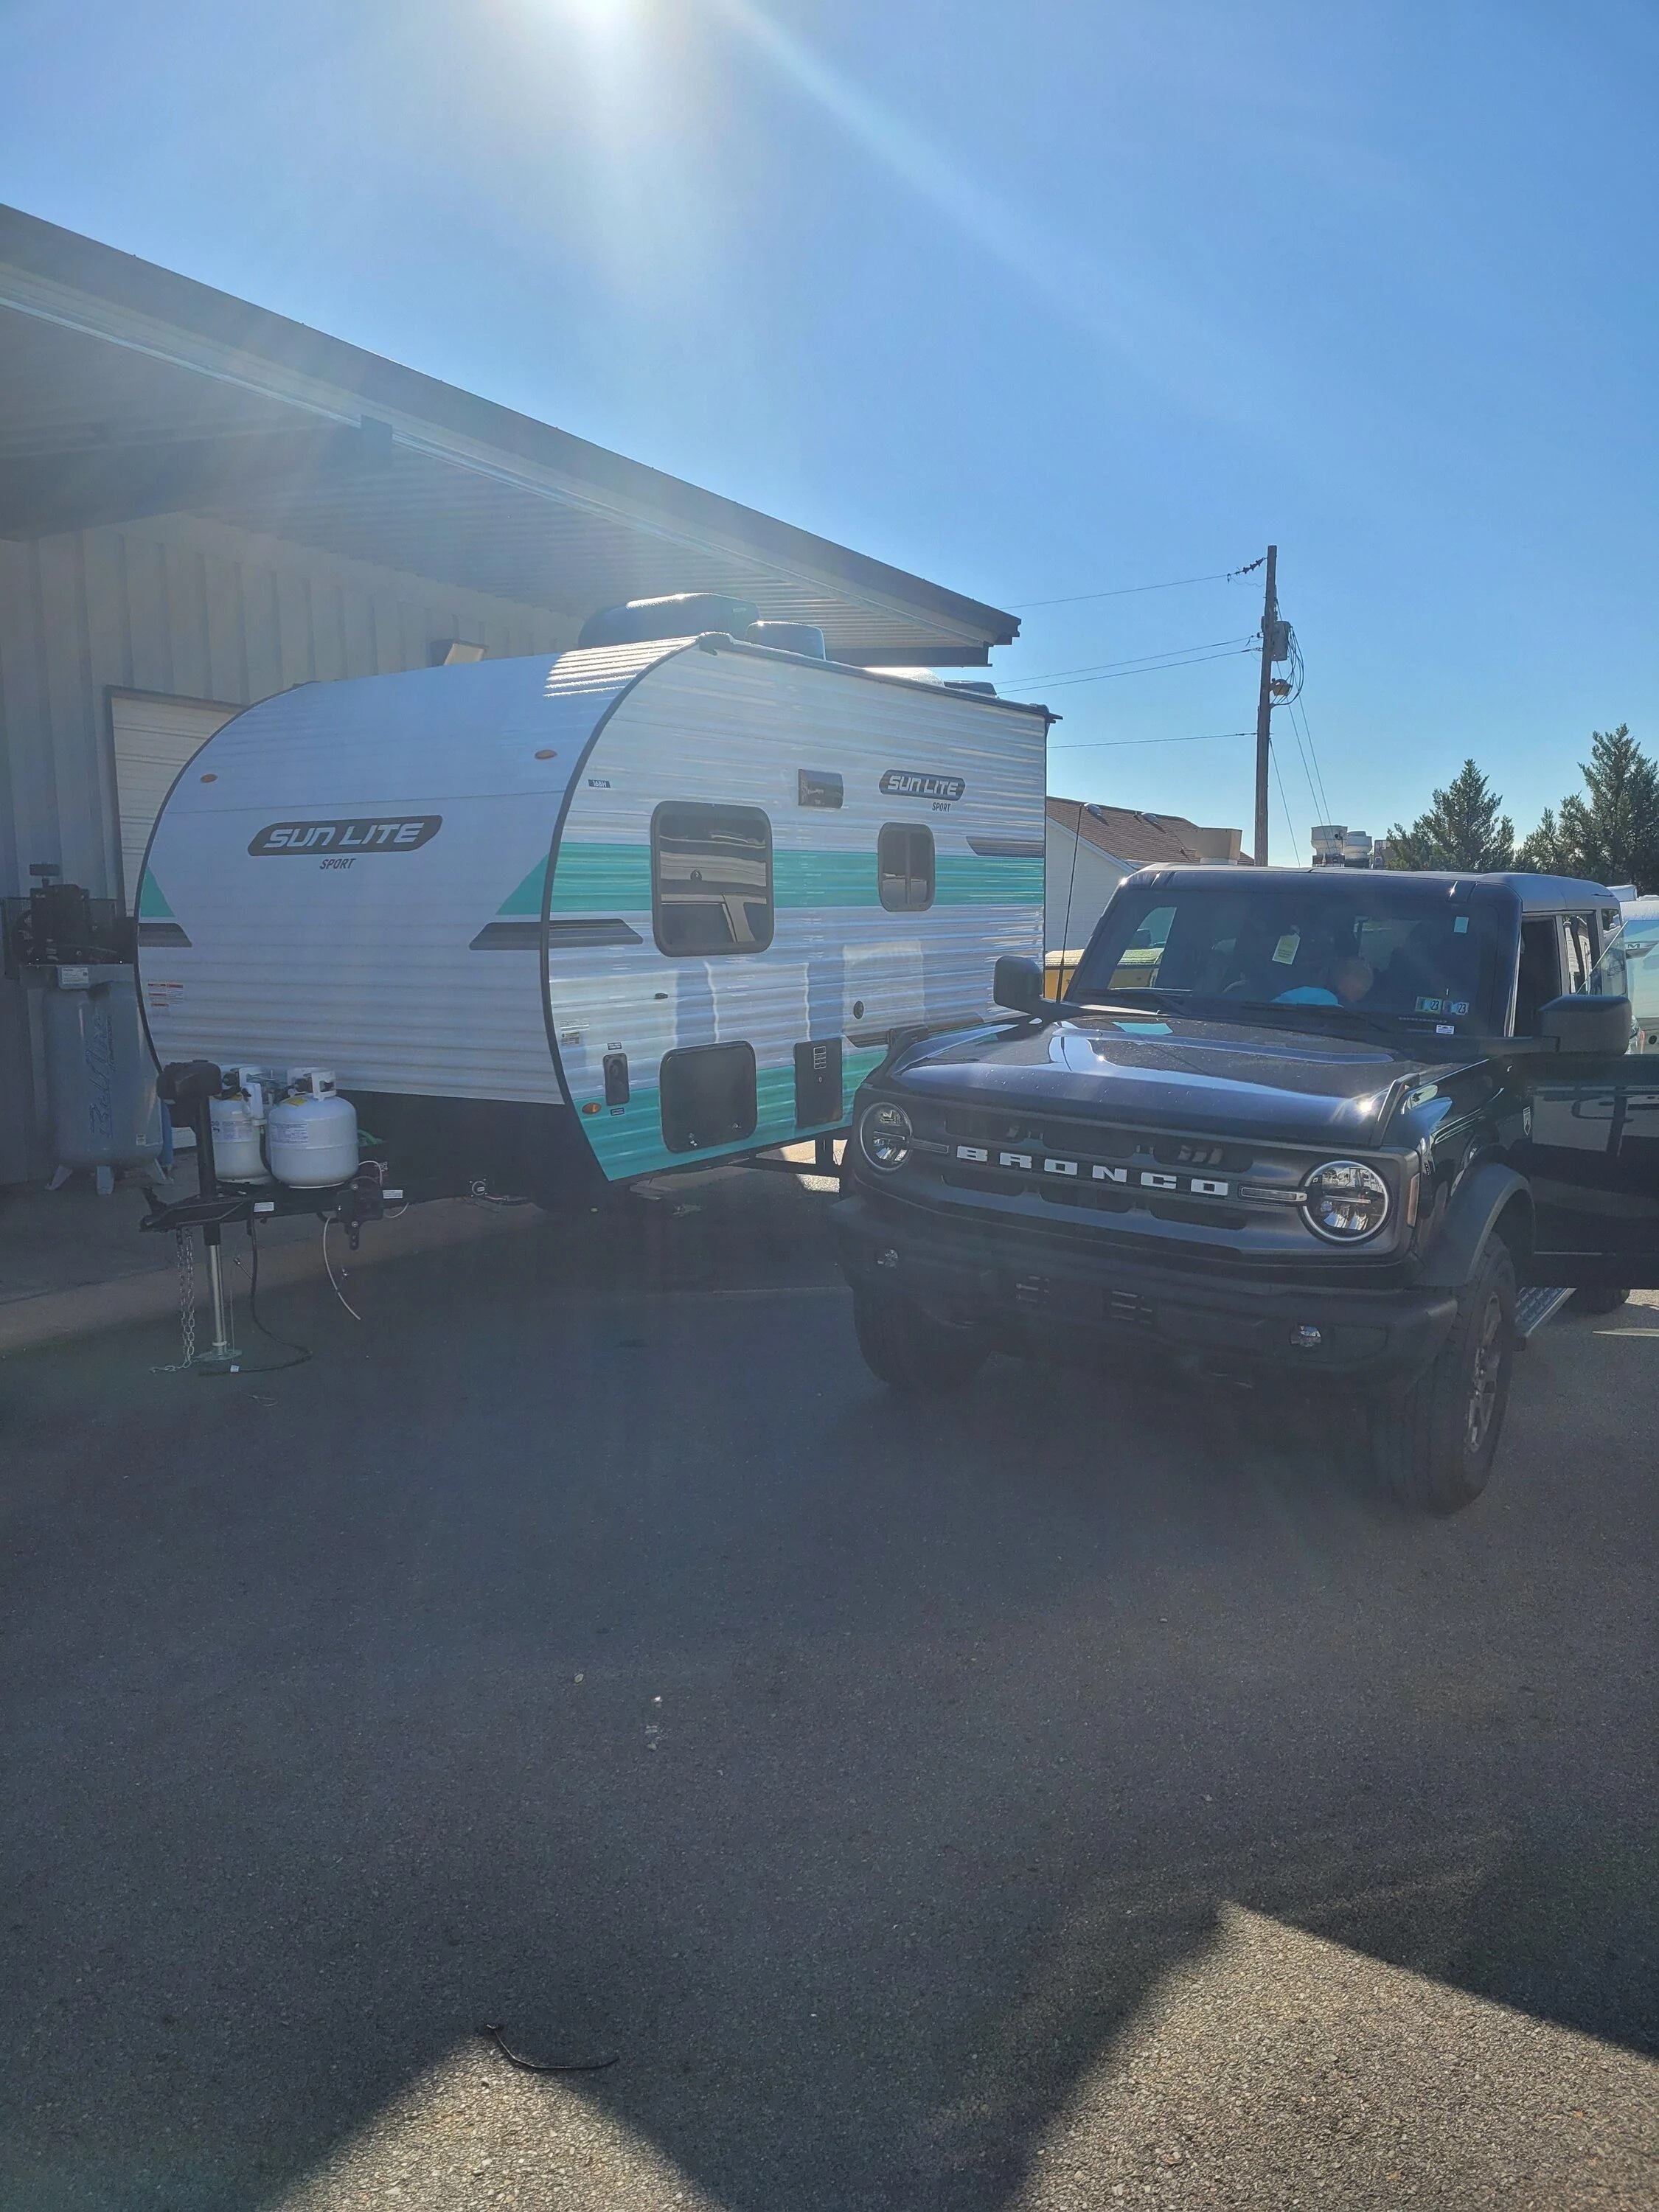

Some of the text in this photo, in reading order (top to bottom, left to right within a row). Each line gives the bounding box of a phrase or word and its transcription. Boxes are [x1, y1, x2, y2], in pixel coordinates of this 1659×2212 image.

[887, 775, 959, 796] SUN LITE
[932, 801, 951, 813] SPORT
[262, 822, 425, 849] SUN LITE
[319, 858, 357, 870] SPORT
[1431, 1000, 1440, 1011] 23
[1458, 1003, 1467, 1014] 23
[956, 1145, 1229, 1196] BRONCO
